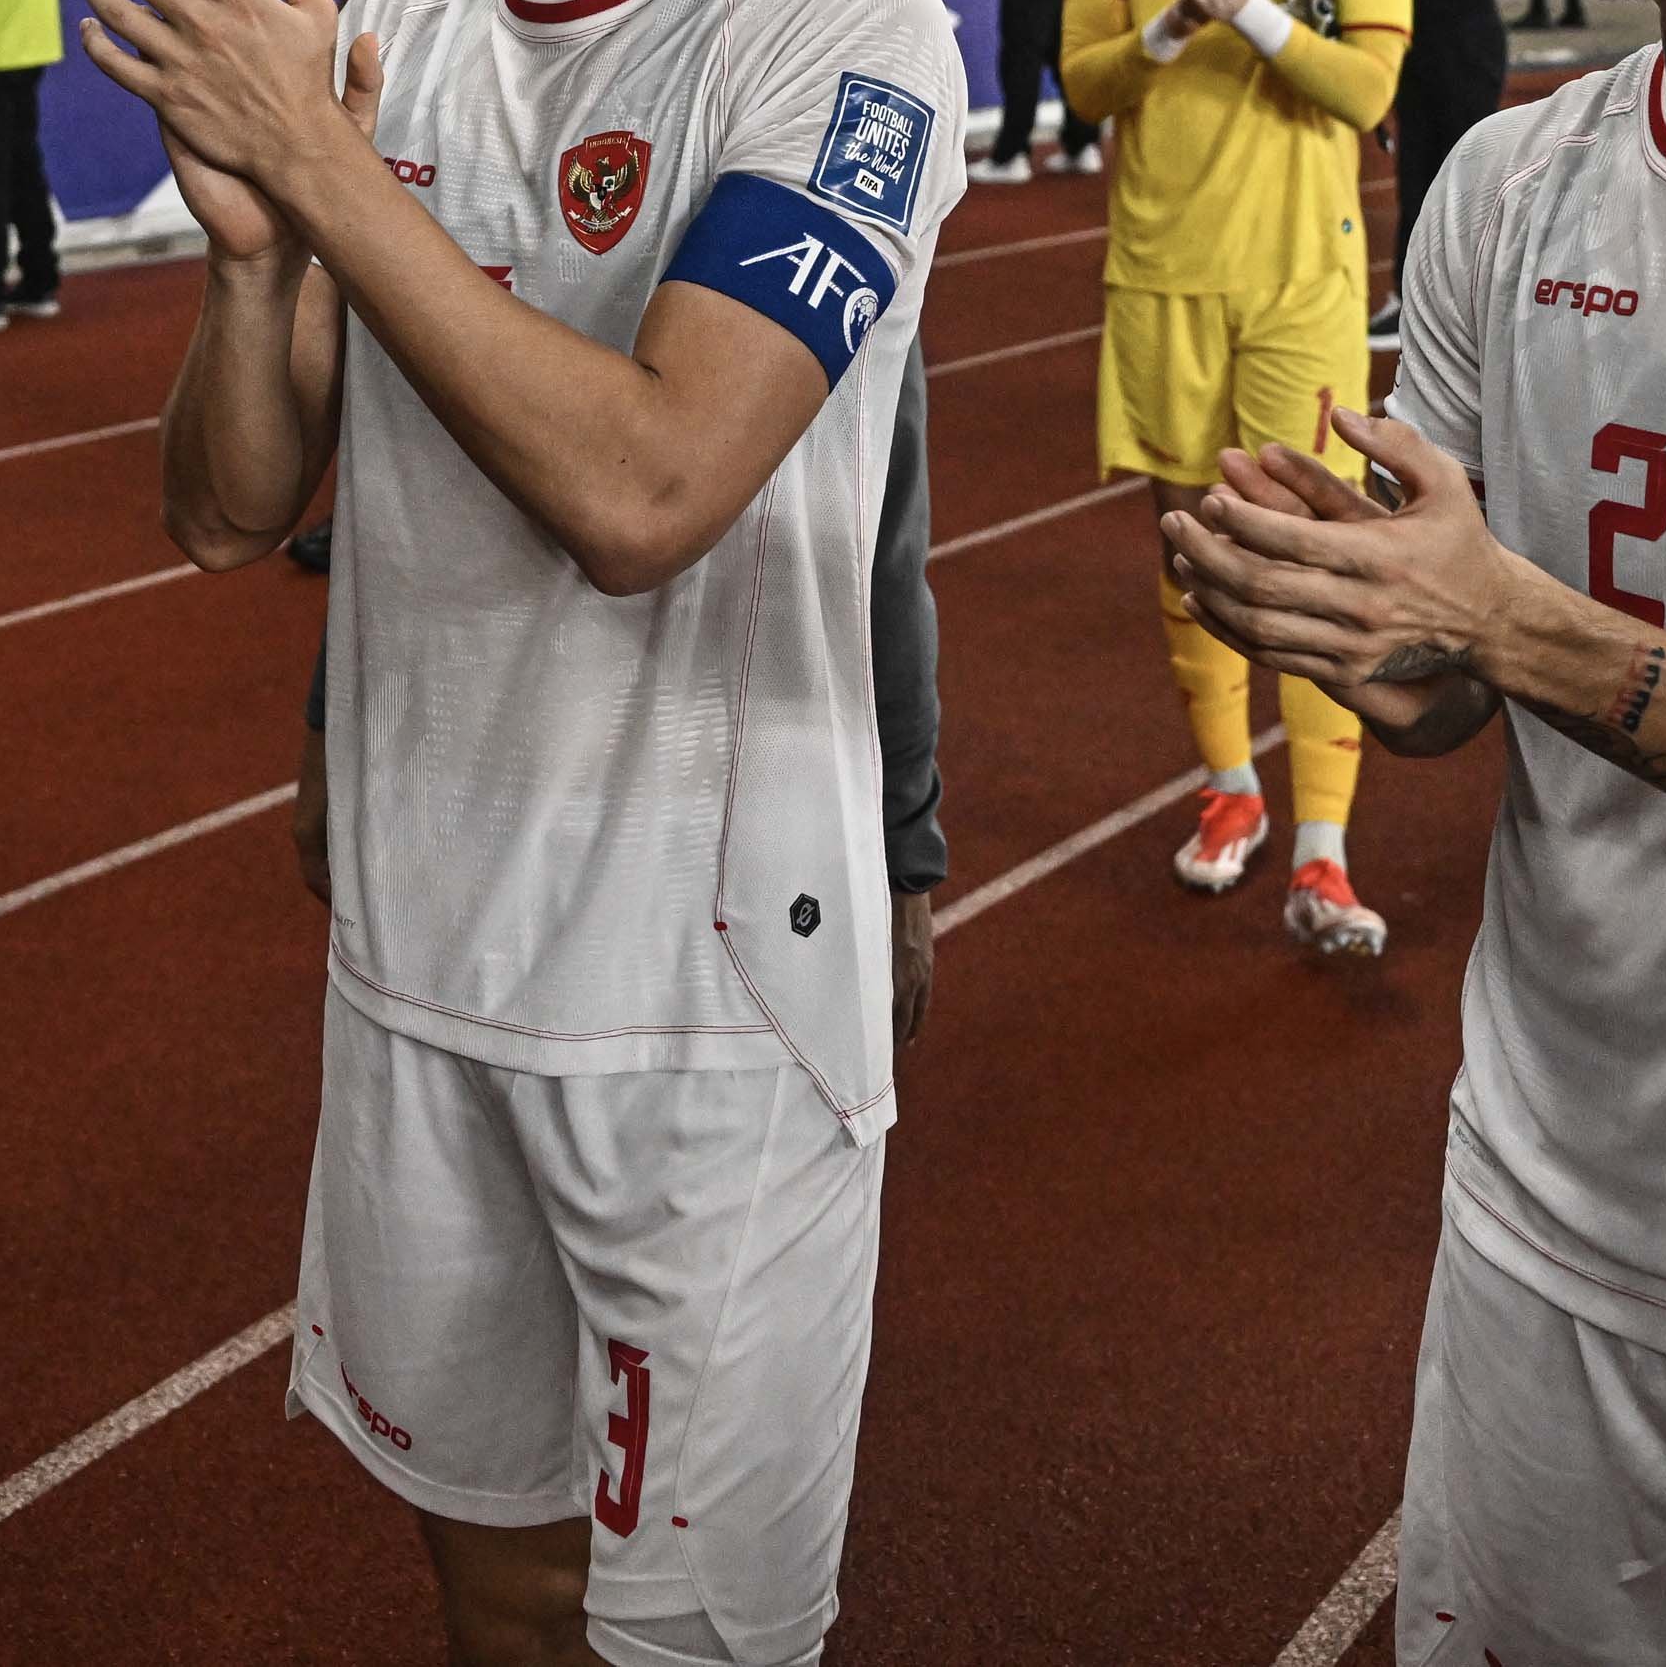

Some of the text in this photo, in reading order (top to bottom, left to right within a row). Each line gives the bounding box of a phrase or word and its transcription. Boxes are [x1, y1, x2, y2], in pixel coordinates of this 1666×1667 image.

[855, 118, 910, 161] UNITES
[862, 100, 914, 139] FOOTBALL
[844, 141, 907, 184] the World
[859, 175, 880, 194] FIFA
[1534, 278, 1639, 317] erspo
[1313, 387, 1332, 455] 1
[594, 1337, 651, 1539] 3
